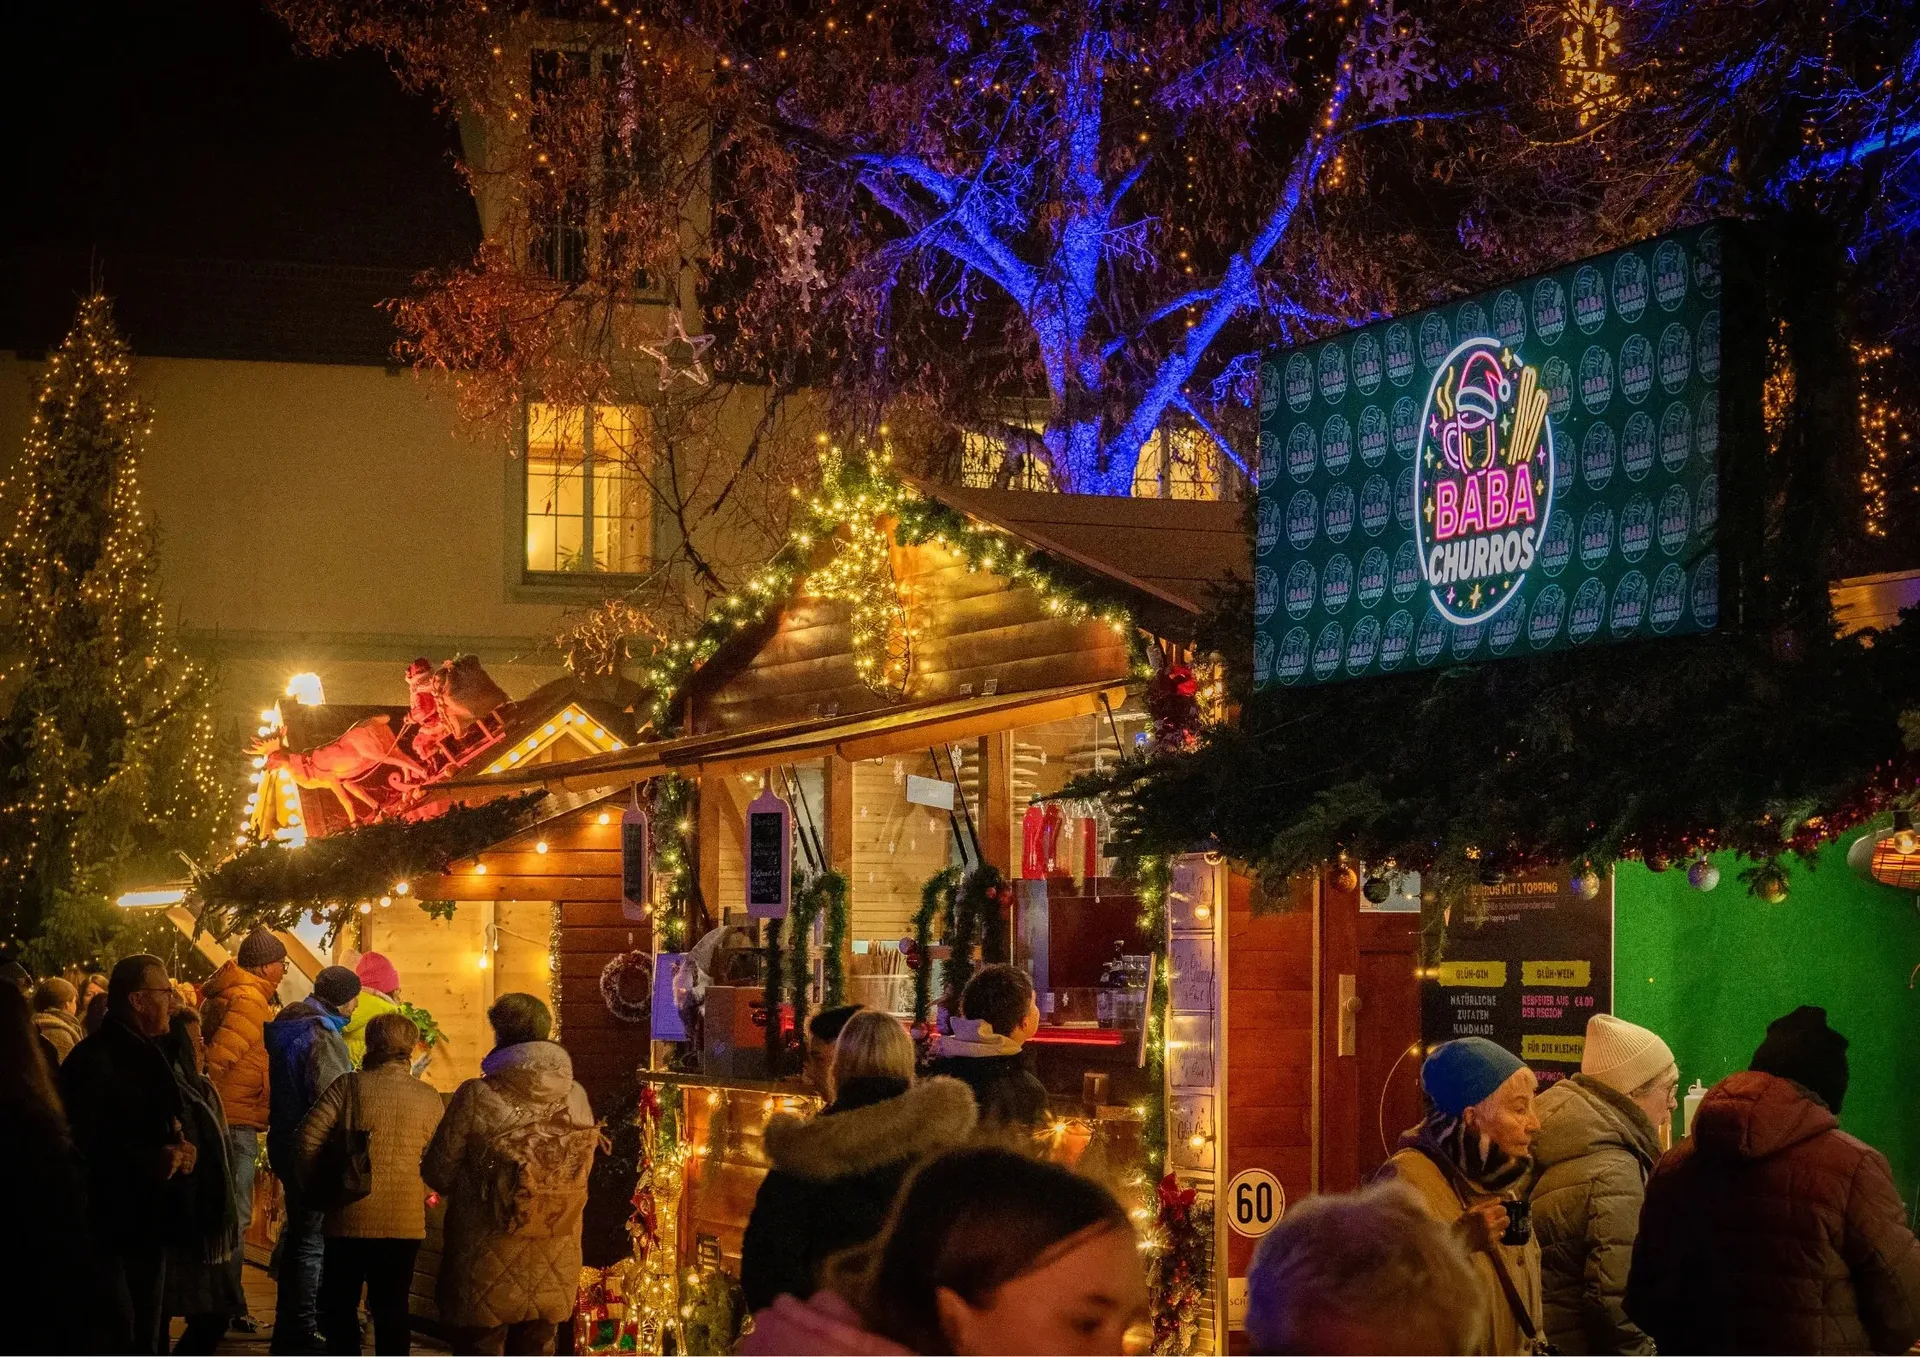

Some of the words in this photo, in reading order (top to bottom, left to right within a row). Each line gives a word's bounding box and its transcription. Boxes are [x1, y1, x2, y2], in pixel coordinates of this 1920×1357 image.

[1436, 463, 1536, 539] BABA
[1428, 528, 1535, 586] CHURROS
[1502, 882, 1516, 896] MIT
[1522, 881, 1558, 894] TOPPING
[1456, 967, 1488, 979] GLÜH-GIN
[1536, 967, 1574, 980] GLÜH-WEIN
[1450, 993, 1496, 1006] NATÜRLICHE
[1555, 995, 1570, 1006] AUS
[1457, 1010, 1489, 1020] ZUTATEN
[1522, 1008, 1536, 1018] DER
[1536, 1007, 1562, 1018] REGION
[1453, 1024, 1494, 1034] HANDMADE
[1528, 1040, 1540, 1053] FÜR
[1542, 1043, 1552, 1054] DIE
[1236, 1182, 1272, 1224] 60
